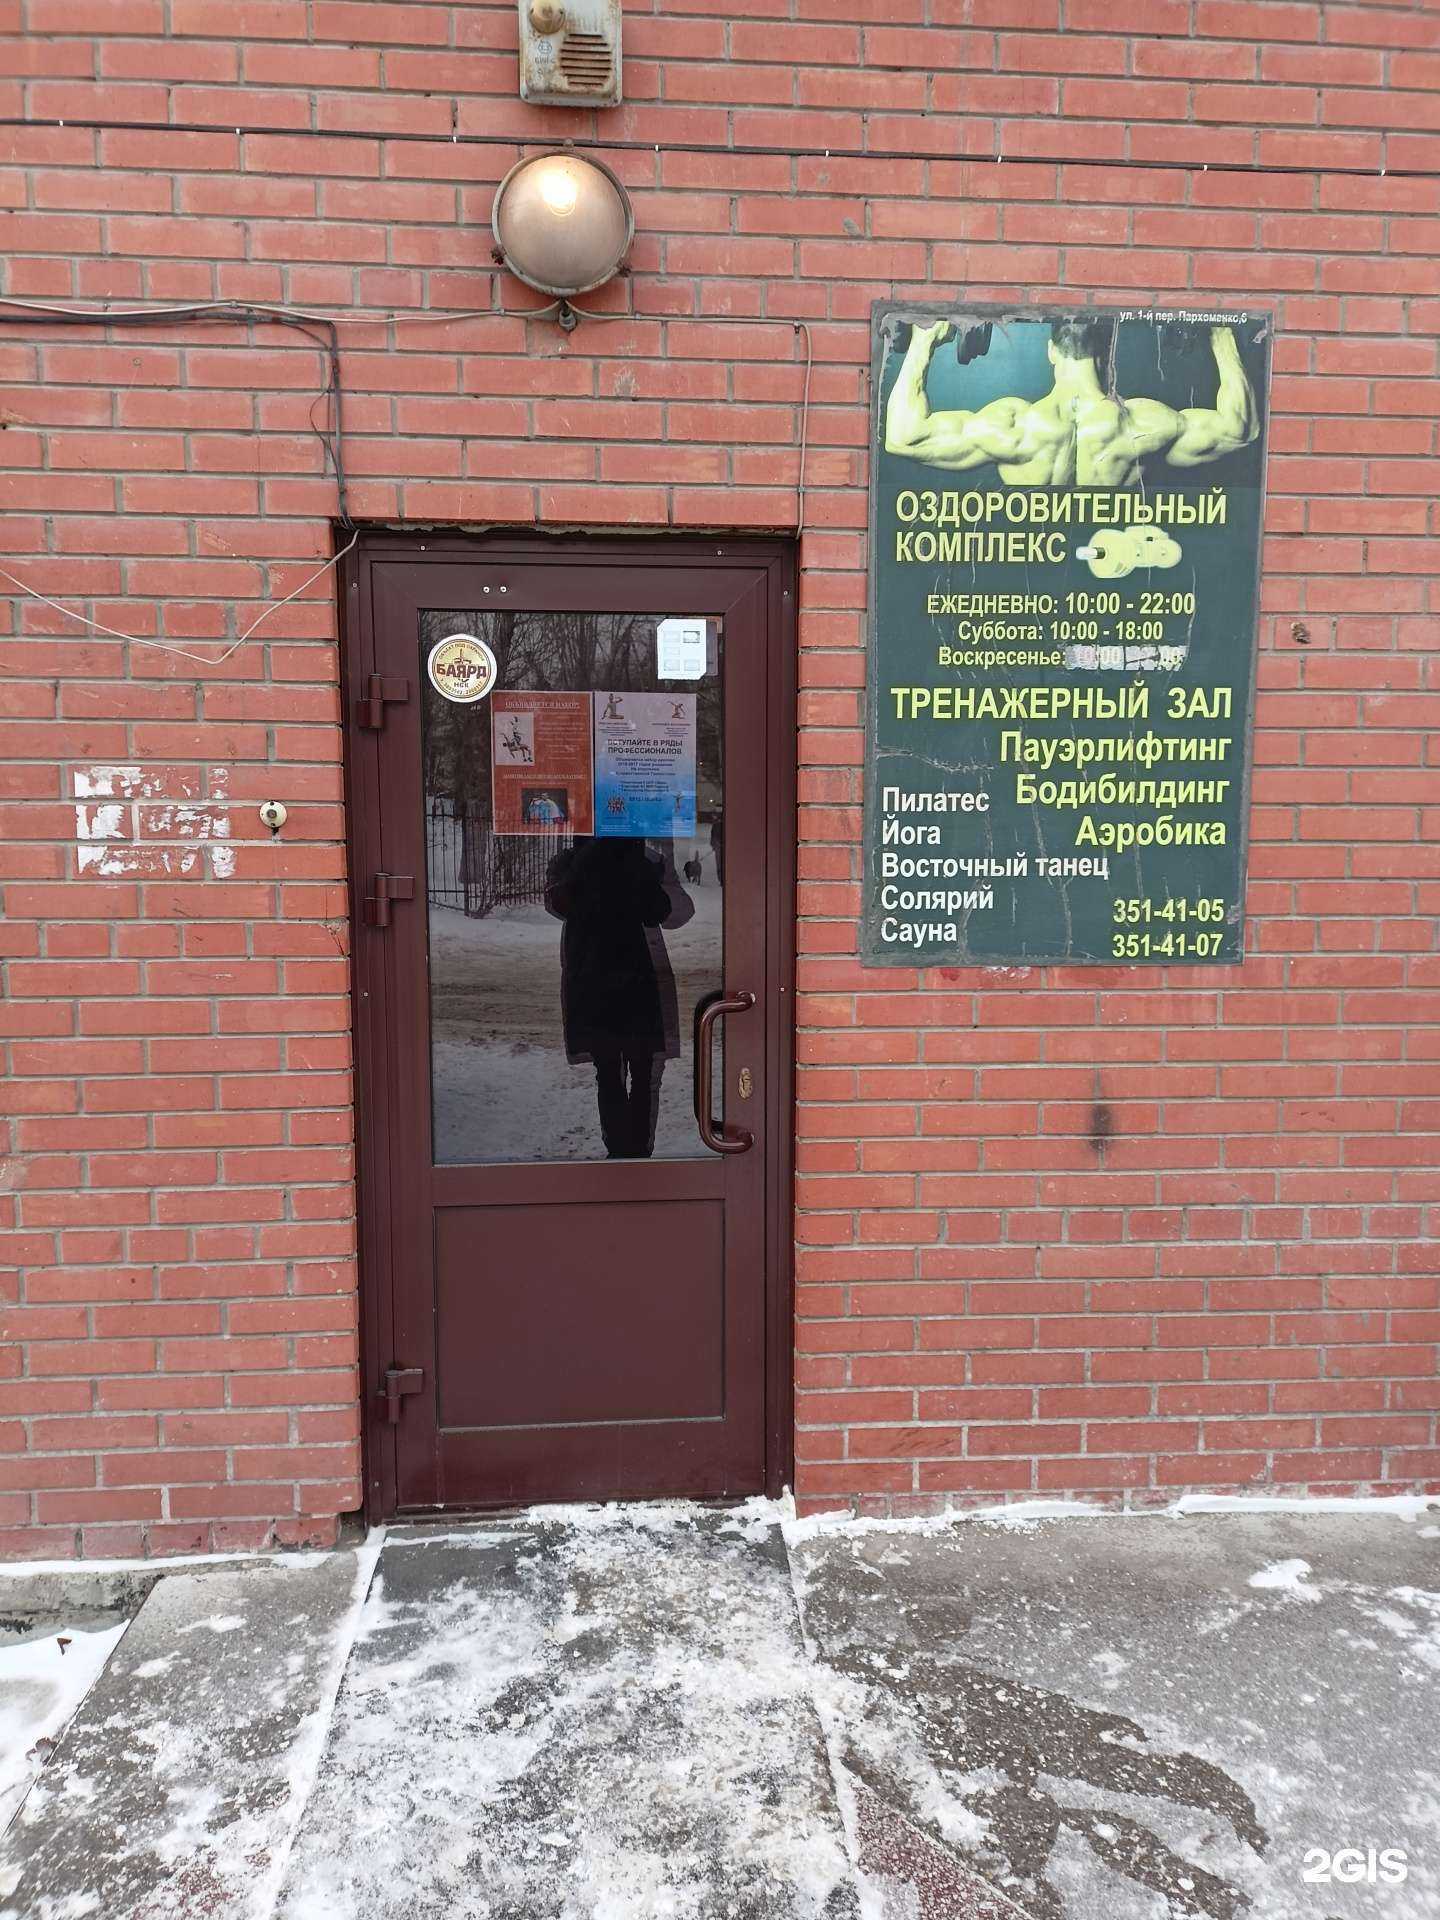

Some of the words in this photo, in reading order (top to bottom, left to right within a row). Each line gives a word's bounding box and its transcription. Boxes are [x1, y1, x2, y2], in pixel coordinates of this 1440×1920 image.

[1119, 310, 1135, 323] ул.
[1155, 312, 1176, 324] пер.
[896, 487, 1227, 528] ОЗДОРОВИТЕЛЬНЫЙ
[896, 531, 1066, 563] КОМПЛЕКС
[927, 595, 1058, 616] ЕЖЕДНЕВНО:
[1065, 593, 1121, 614] 10:00
[1140, 593, 1196, 615] 22:00
[958, 620, 1043, 644] Суббота:
[1050, 621, 1098, 640] 10:00
[1115, 621, 1163, 640] 18:00
[436, 663, 487, 679] БАЯРД
[938, 646, 1066, 668] Воскресенье:
[891, 681, 1149, 719] ТРЕНАЖЕРНЫЙ
[1167, 687, 1232, 719] ЗАЛ
[1000, 731, 1232, 769] Пауэрлифтинг
[882, 787, 990, 812] Пилатес
[1017, 774, 1230, 807] Бодибилдинг
[882, 814, 941, 845] Йога
[1075, 816, 1226, 853] Аэробика
[882, 852, 1028, 877] Восточный
[1035, 857, 1109, 880] танец
[881, 885, 994, 914] Солярий
[1113, 899, 1225, 922] 351-41-05
[881, 918, 957, 947] Сауна
[1112, 932, 1224, 957] 351-41-07
